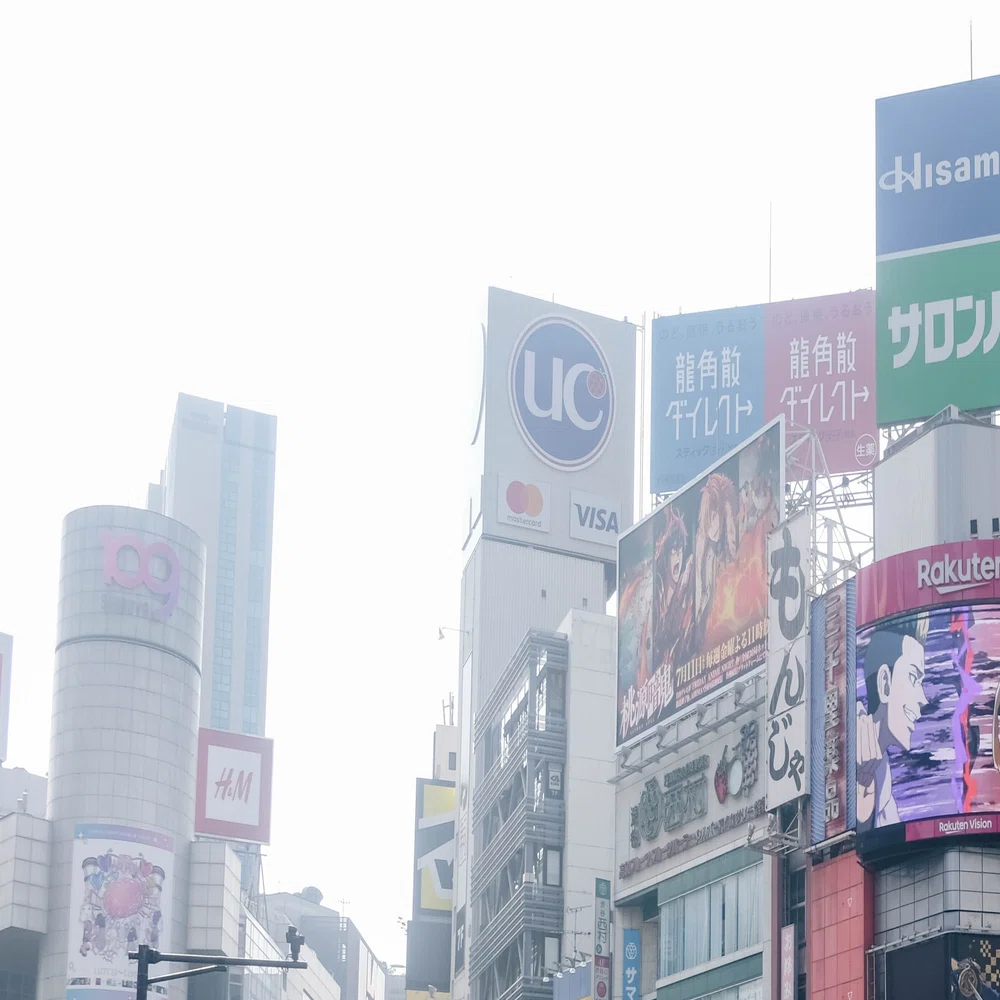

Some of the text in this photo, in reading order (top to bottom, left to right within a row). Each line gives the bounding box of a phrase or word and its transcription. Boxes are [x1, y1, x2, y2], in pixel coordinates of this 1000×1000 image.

[675, 345, 741, 393] 龍角散
[790, 331, 857, 380] 龍角散
[665, 393, 754, 440] ダイレクト
[779, 379, 870, 426] ダイレクト
[856, 444, 875, 458] 生薬
[507, 513, 543, 528] mastercard
[573, 503, 619, 534] VISA
[769, 527, 806, 792] もんじゃ
[215, 767, 253, 804] H&M
[939, 817, 992, 833] Rakuten Vision
